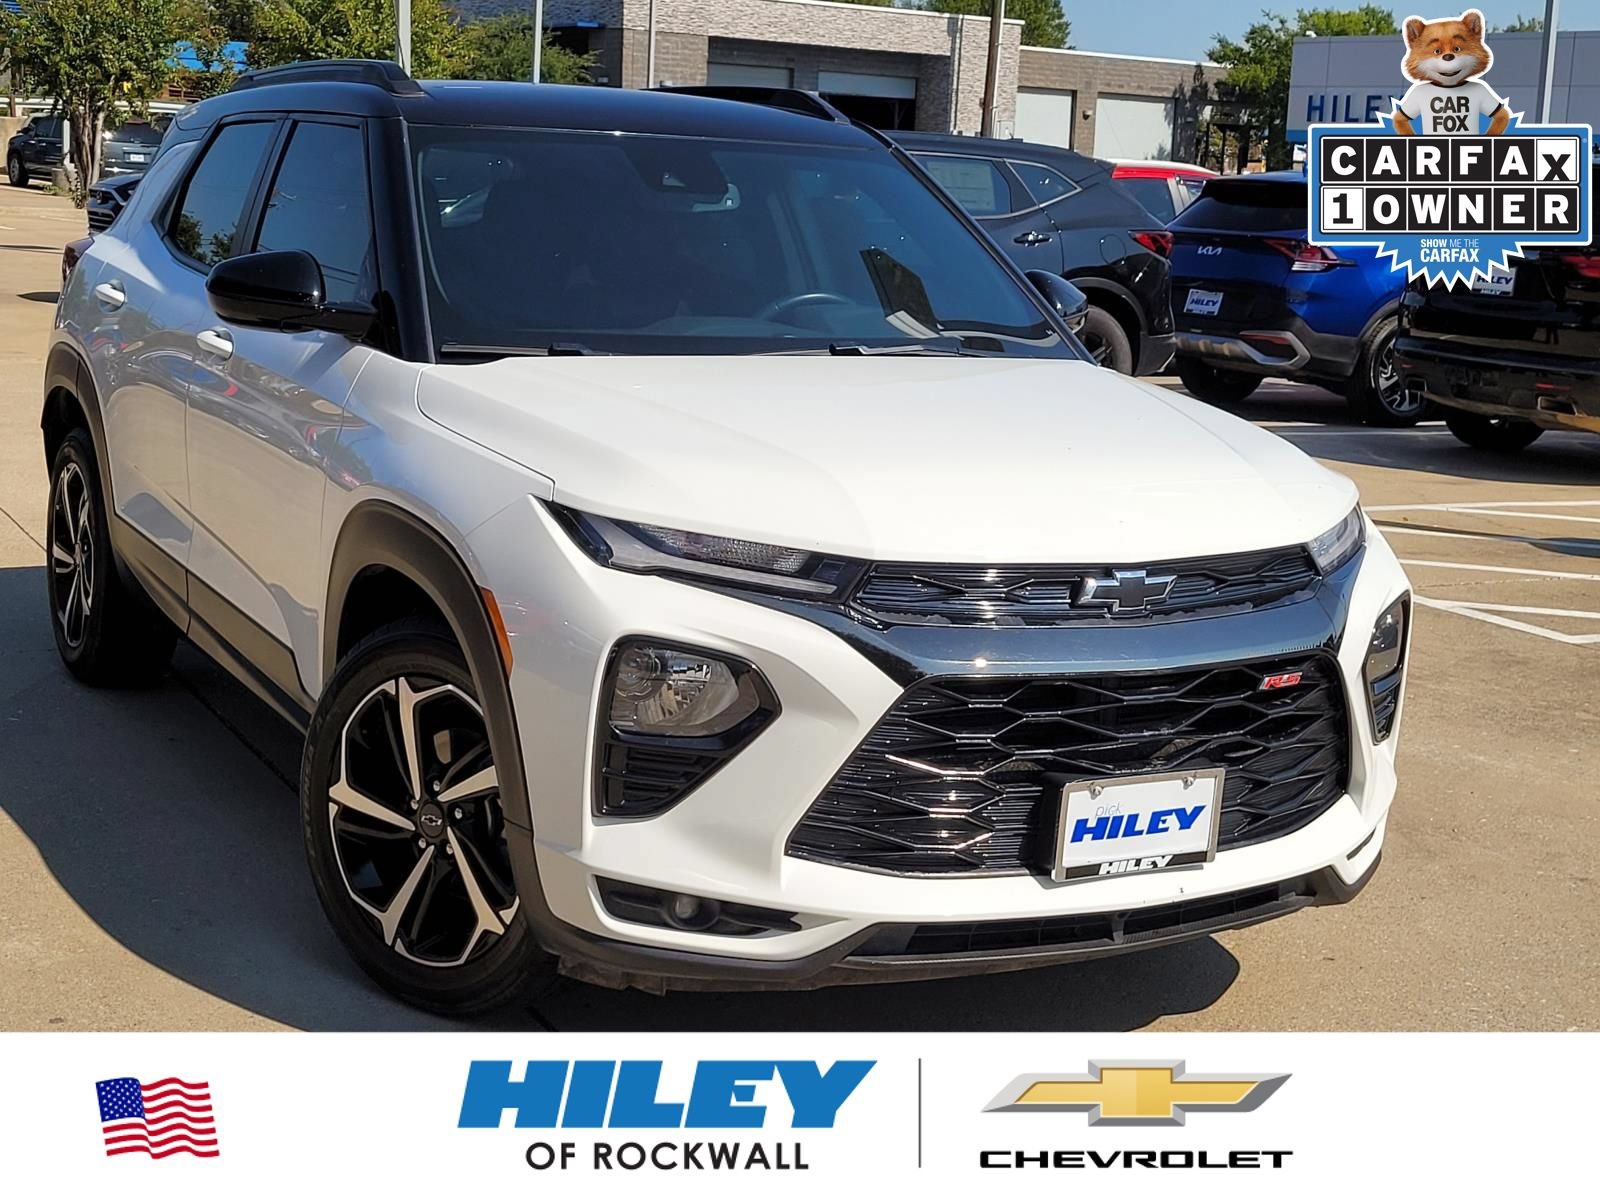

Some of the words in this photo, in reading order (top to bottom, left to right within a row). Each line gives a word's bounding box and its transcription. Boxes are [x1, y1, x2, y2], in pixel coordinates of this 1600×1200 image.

[1259, 672, 1302, 690] RS
[1070, 805, 1206, 843] HILEY
[1099, 854, 1174, 875] HILEY
